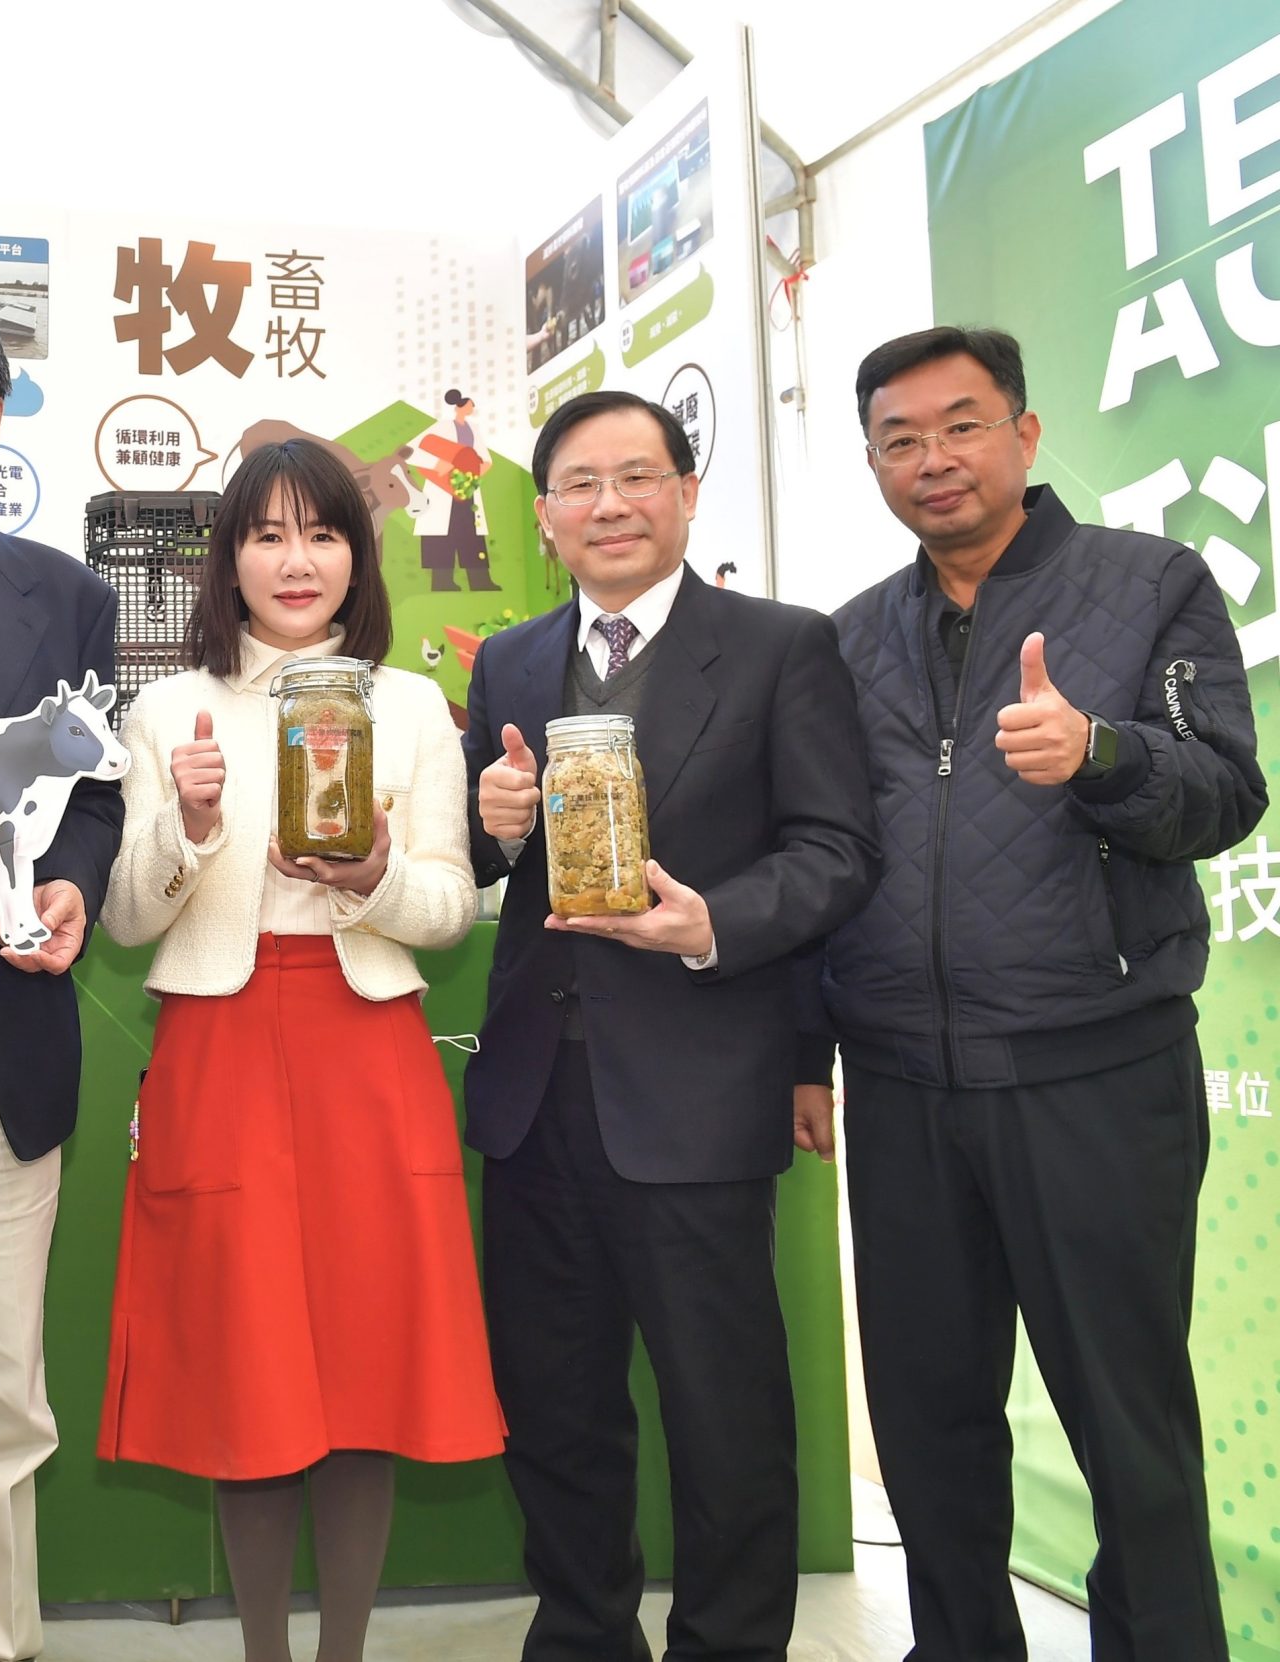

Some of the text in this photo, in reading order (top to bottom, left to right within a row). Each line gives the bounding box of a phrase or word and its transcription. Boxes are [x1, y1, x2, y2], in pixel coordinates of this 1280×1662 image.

[113, 236, 255, 379] 牧
[265, 249, 327, 379] 畜牧
[115, 428, 181, 447] 循環利用
[115, 448, 181, 467] 兼顧健康
[1164, 678, 1182, 719] CALVIN
